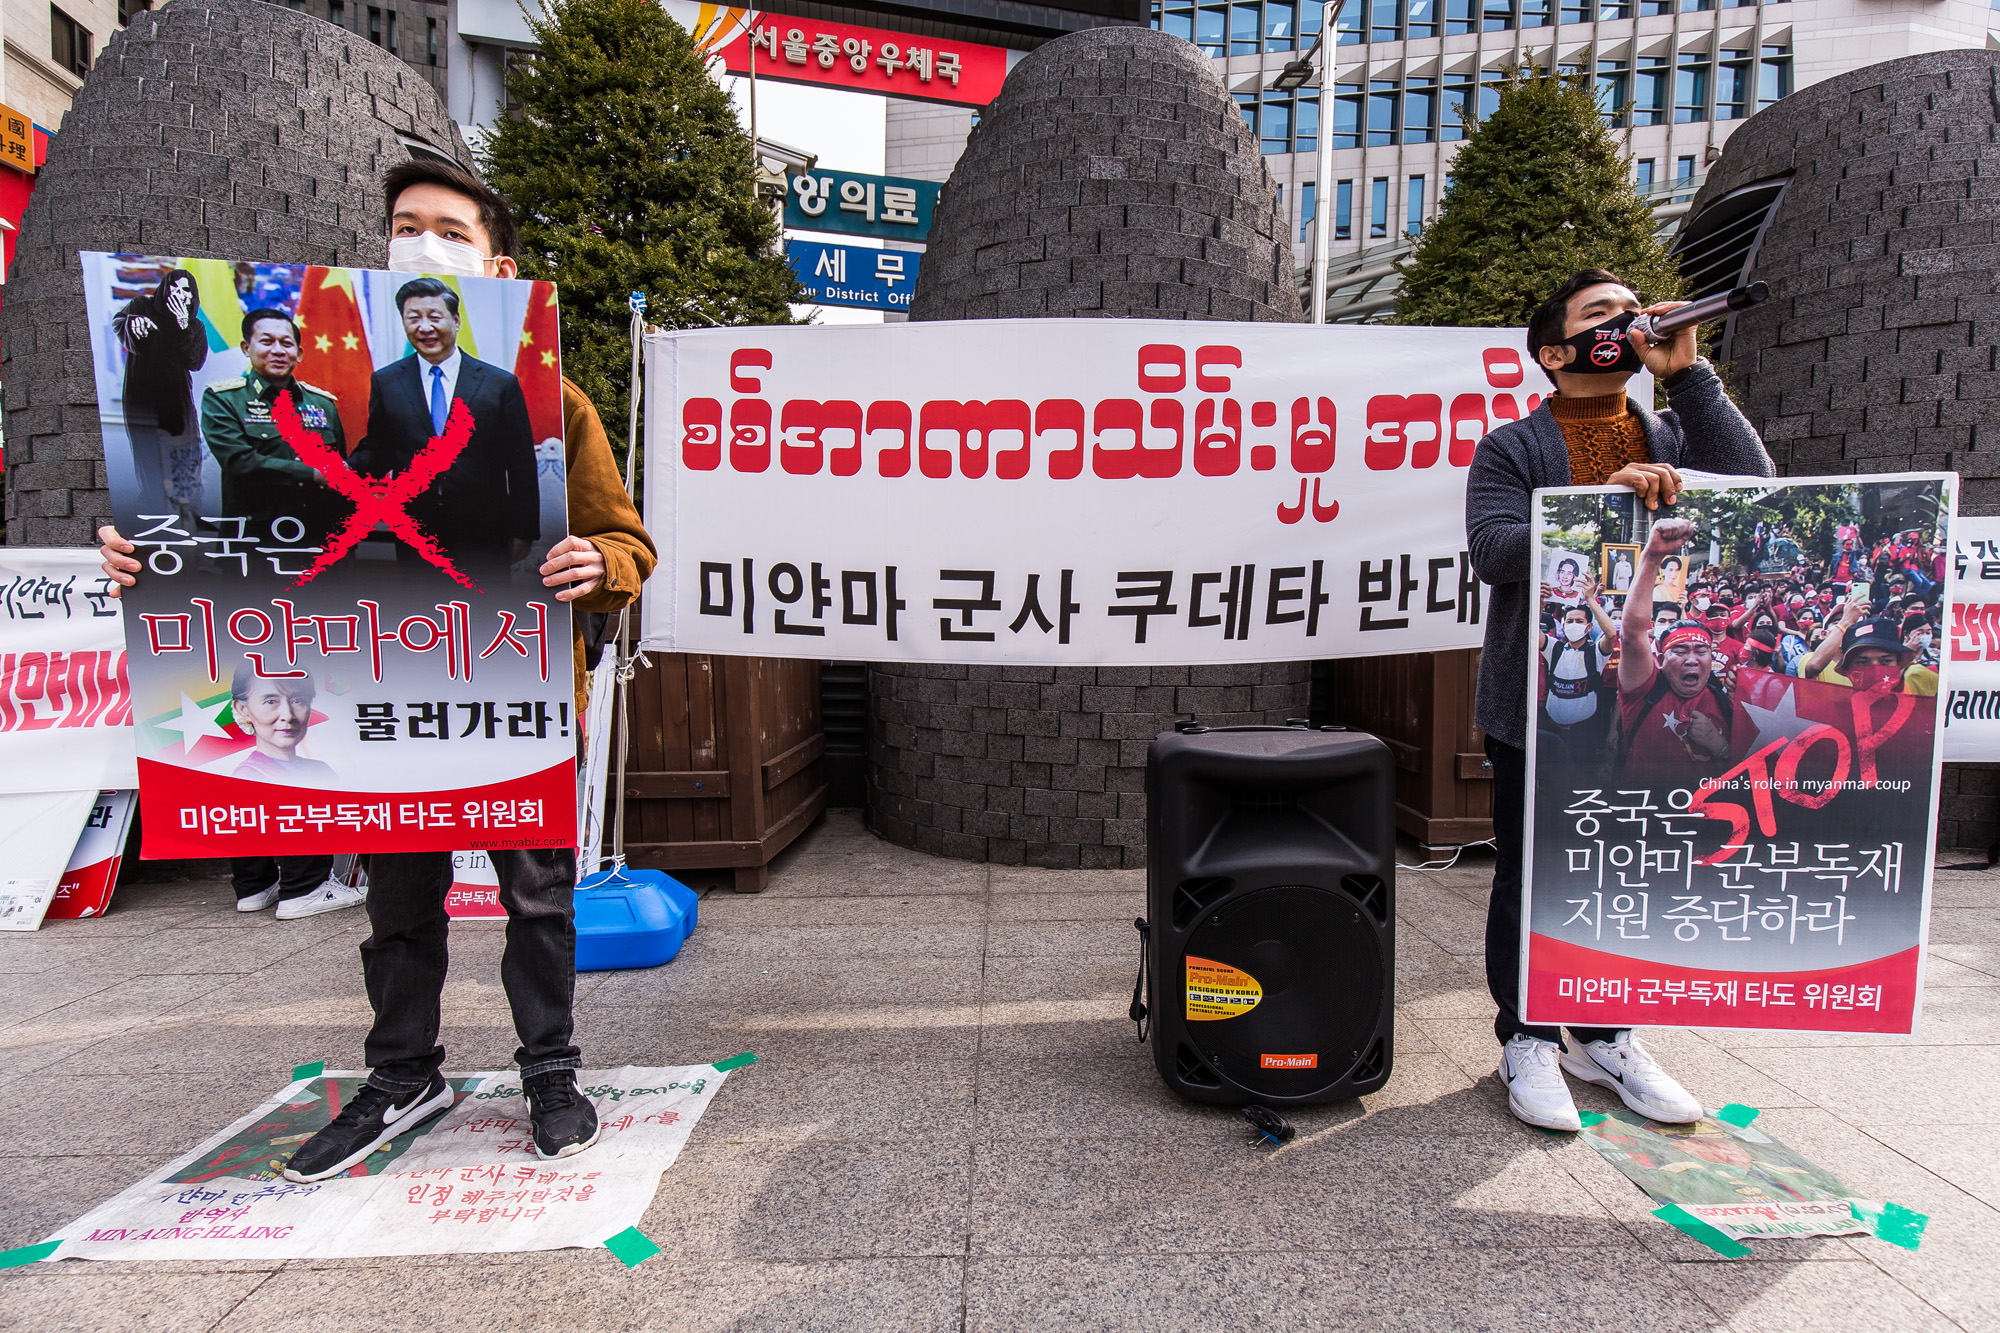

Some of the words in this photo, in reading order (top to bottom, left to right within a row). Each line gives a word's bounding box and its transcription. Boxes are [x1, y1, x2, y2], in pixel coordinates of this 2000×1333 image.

[754, 25, 963, 87] 서울중앙우체국
[826, 286, 879, 303] District
[887, 292, 915, 305] Off
[124, 513, 324, 577] 중국은
[699, 557, 907, 642] 미얀마
[932, 568, 1081, 645] 군사
[1107, 559, 1330, 644] 쿠데타
[1358, 550, 1480, 633] 반대
[139, 597, 550, 683] 미얀마에서
[354, 700, 570, 742] 물러가라!
[1698, 775, 1751, 790] China's
[1754, 776, 1782, 790] role
[1785, 777, 1799, 790] in
[1802, 779, 1872, 794] myanmar
[1874, 779, 1911, 794] coup
[180, 803, 270, 836] 미얀마
[275, 802, 392, 833] 군부독재
[398, 801, 456, 830] 타도
[461, 798, 545, 829] 위원회
[1563, 788, 1706, 837] 중국은
[470, 837, 566, 850] www.myabiz.com
[1564, 839, 1704, 891] 미얀마
[1710, 841, 1904, 894] 군부독재
[449, 889, 497, 907] 군부독재
[1562, 890, 1651, 941] 지원
[1660, 892, 1857, 947] 중단하라
[1189, 985, 1224, 995] DESIGNED
[1558, 976, 1633, 1004] 미얀마
[1636, 978, 1739, 1008] 군부독재
[1744, 980, 1796, 1007] 타도
[1802, 982, 1882, 1012] 위원회
[407, 1183, 455, 1207] 인정
[80, 1227, 136, 1242] MIN
[132, 1226, 206, 1241] AUNG
[200, 1224, 295, 1240] HLAING
[427, 1205, 548, 1225] 부탁합니다
